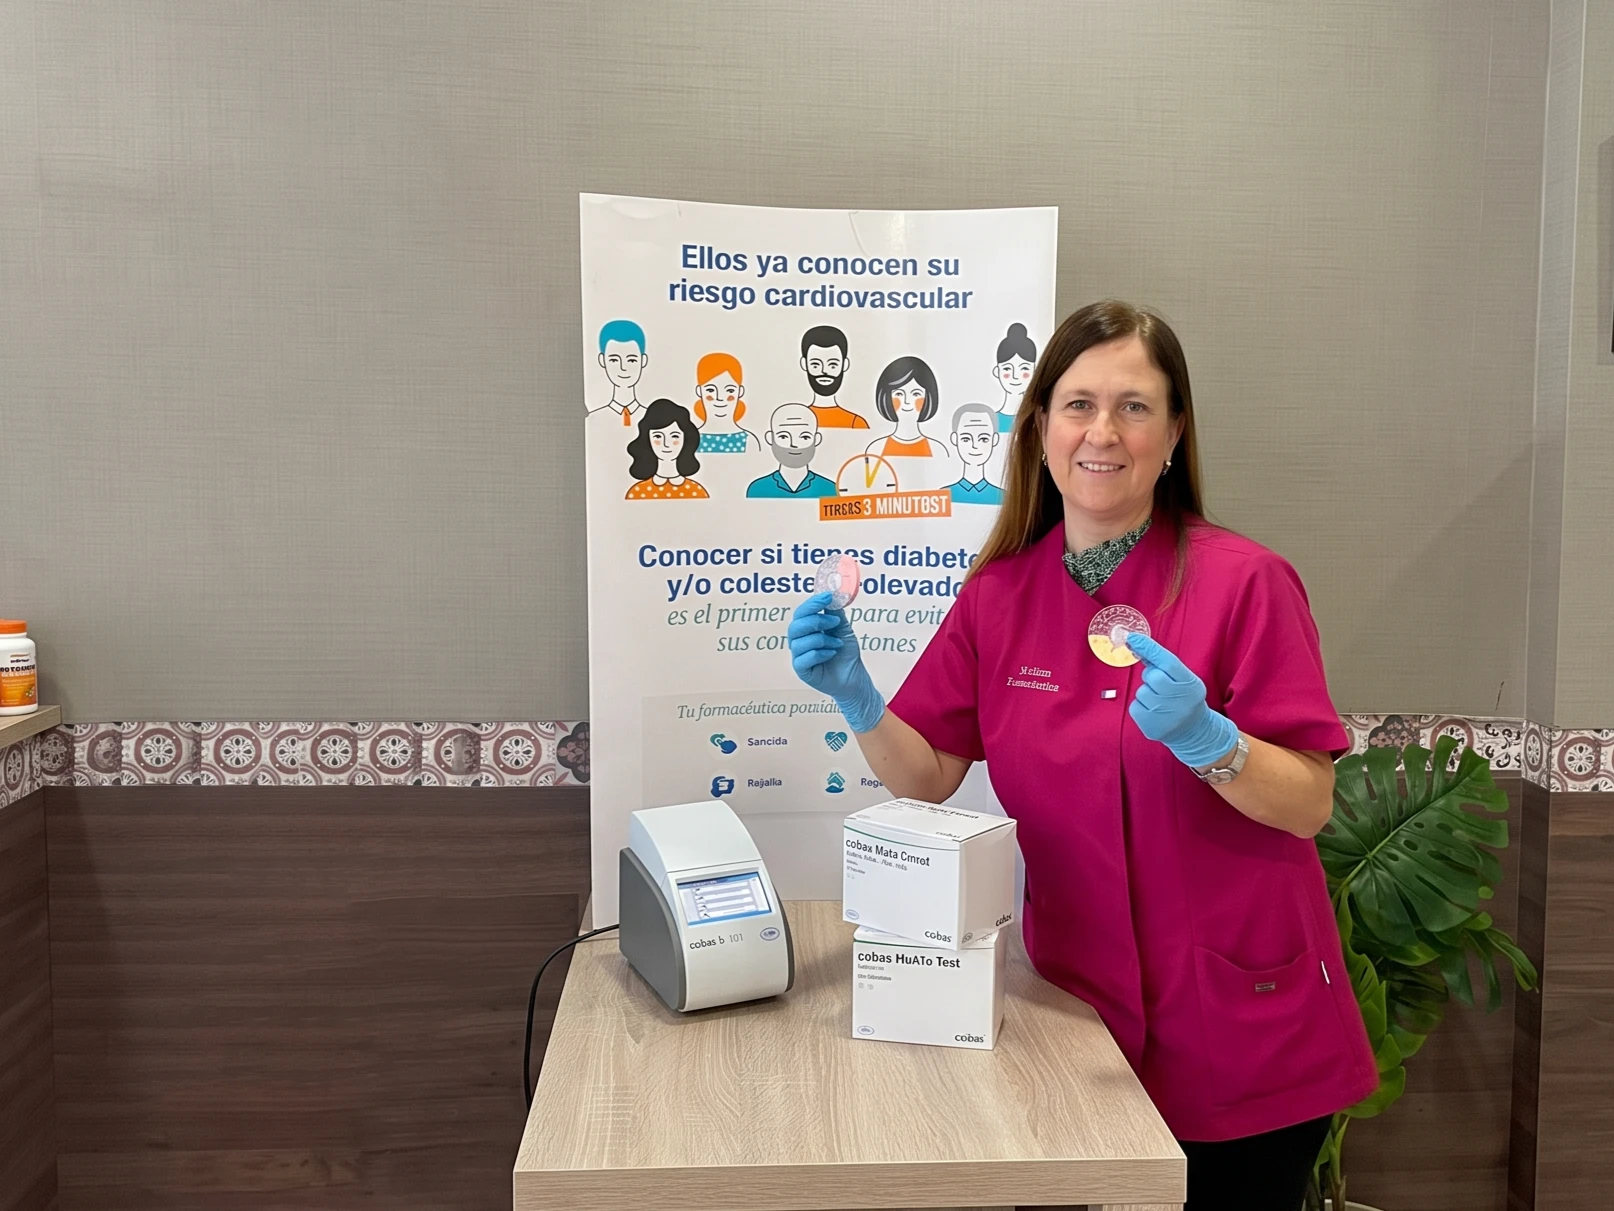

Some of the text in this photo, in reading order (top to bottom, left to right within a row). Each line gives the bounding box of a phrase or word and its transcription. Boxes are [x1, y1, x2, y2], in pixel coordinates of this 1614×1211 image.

[682, 244, 960, 277] Ellos ya conocen su
[669, 278, 973, 310] riesgo cardiovascular
[863, 498, 872, 516] 3
[638, 544, 753, 567] Conocer
[760, 543, 783, 564] si
[667, 573, 711, 601] y/o
[667, 608, 688, 626] es
[694, 602, 712, 625] el
[716, 602, 791, 629] primer
[850, 606, 899, 627] para
[717, 635, 750, 652] sus
[677, 704, 695, 719] Tu
[747, 736, 788, 746] Sancida
[875, 845, 898, 860] Mata
[690, 933, 744, 949] cobas b 101
[924, 930, 952, 943] cobas
[858, 951, 892, 964] cobas
[936, 956, 961, 969] Test
[954, 1033, 985, 1044] cobas
